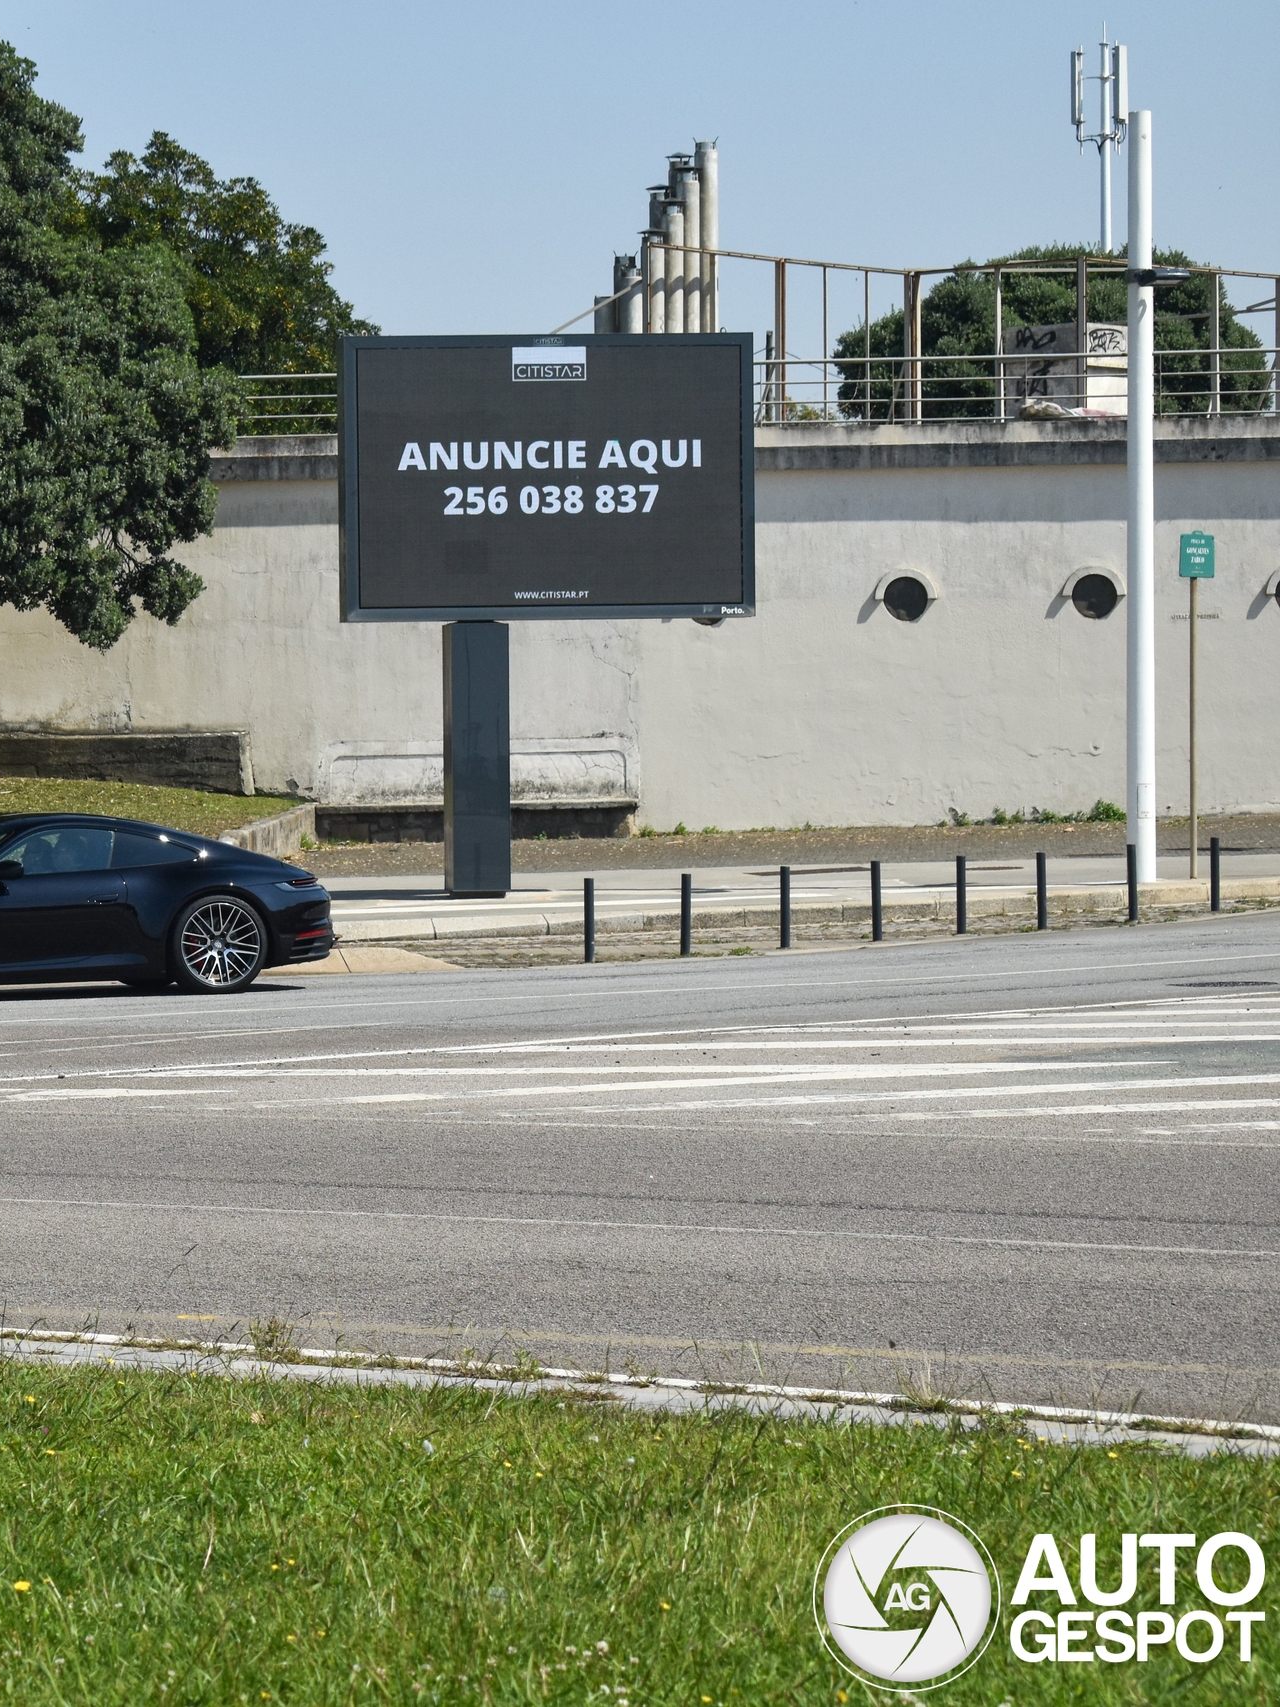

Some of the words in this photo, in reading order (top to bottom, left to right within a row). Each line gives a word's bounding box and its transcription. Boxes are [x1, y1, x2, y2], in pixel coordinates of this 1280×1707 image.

[516, 365, 582, 378] CITISTAR
[397, 440, 587, 471] ANUNCIE
[598, 439, 702, 475] AQUI
[443, 485, 509, 516] 256
[519, 484, 584, 515] 038
[595, 484, 660, 514] 837
[514, 590, 589, 600] WWW.CITISTAR.PT
[721, 606, 745, 615] Porto.
